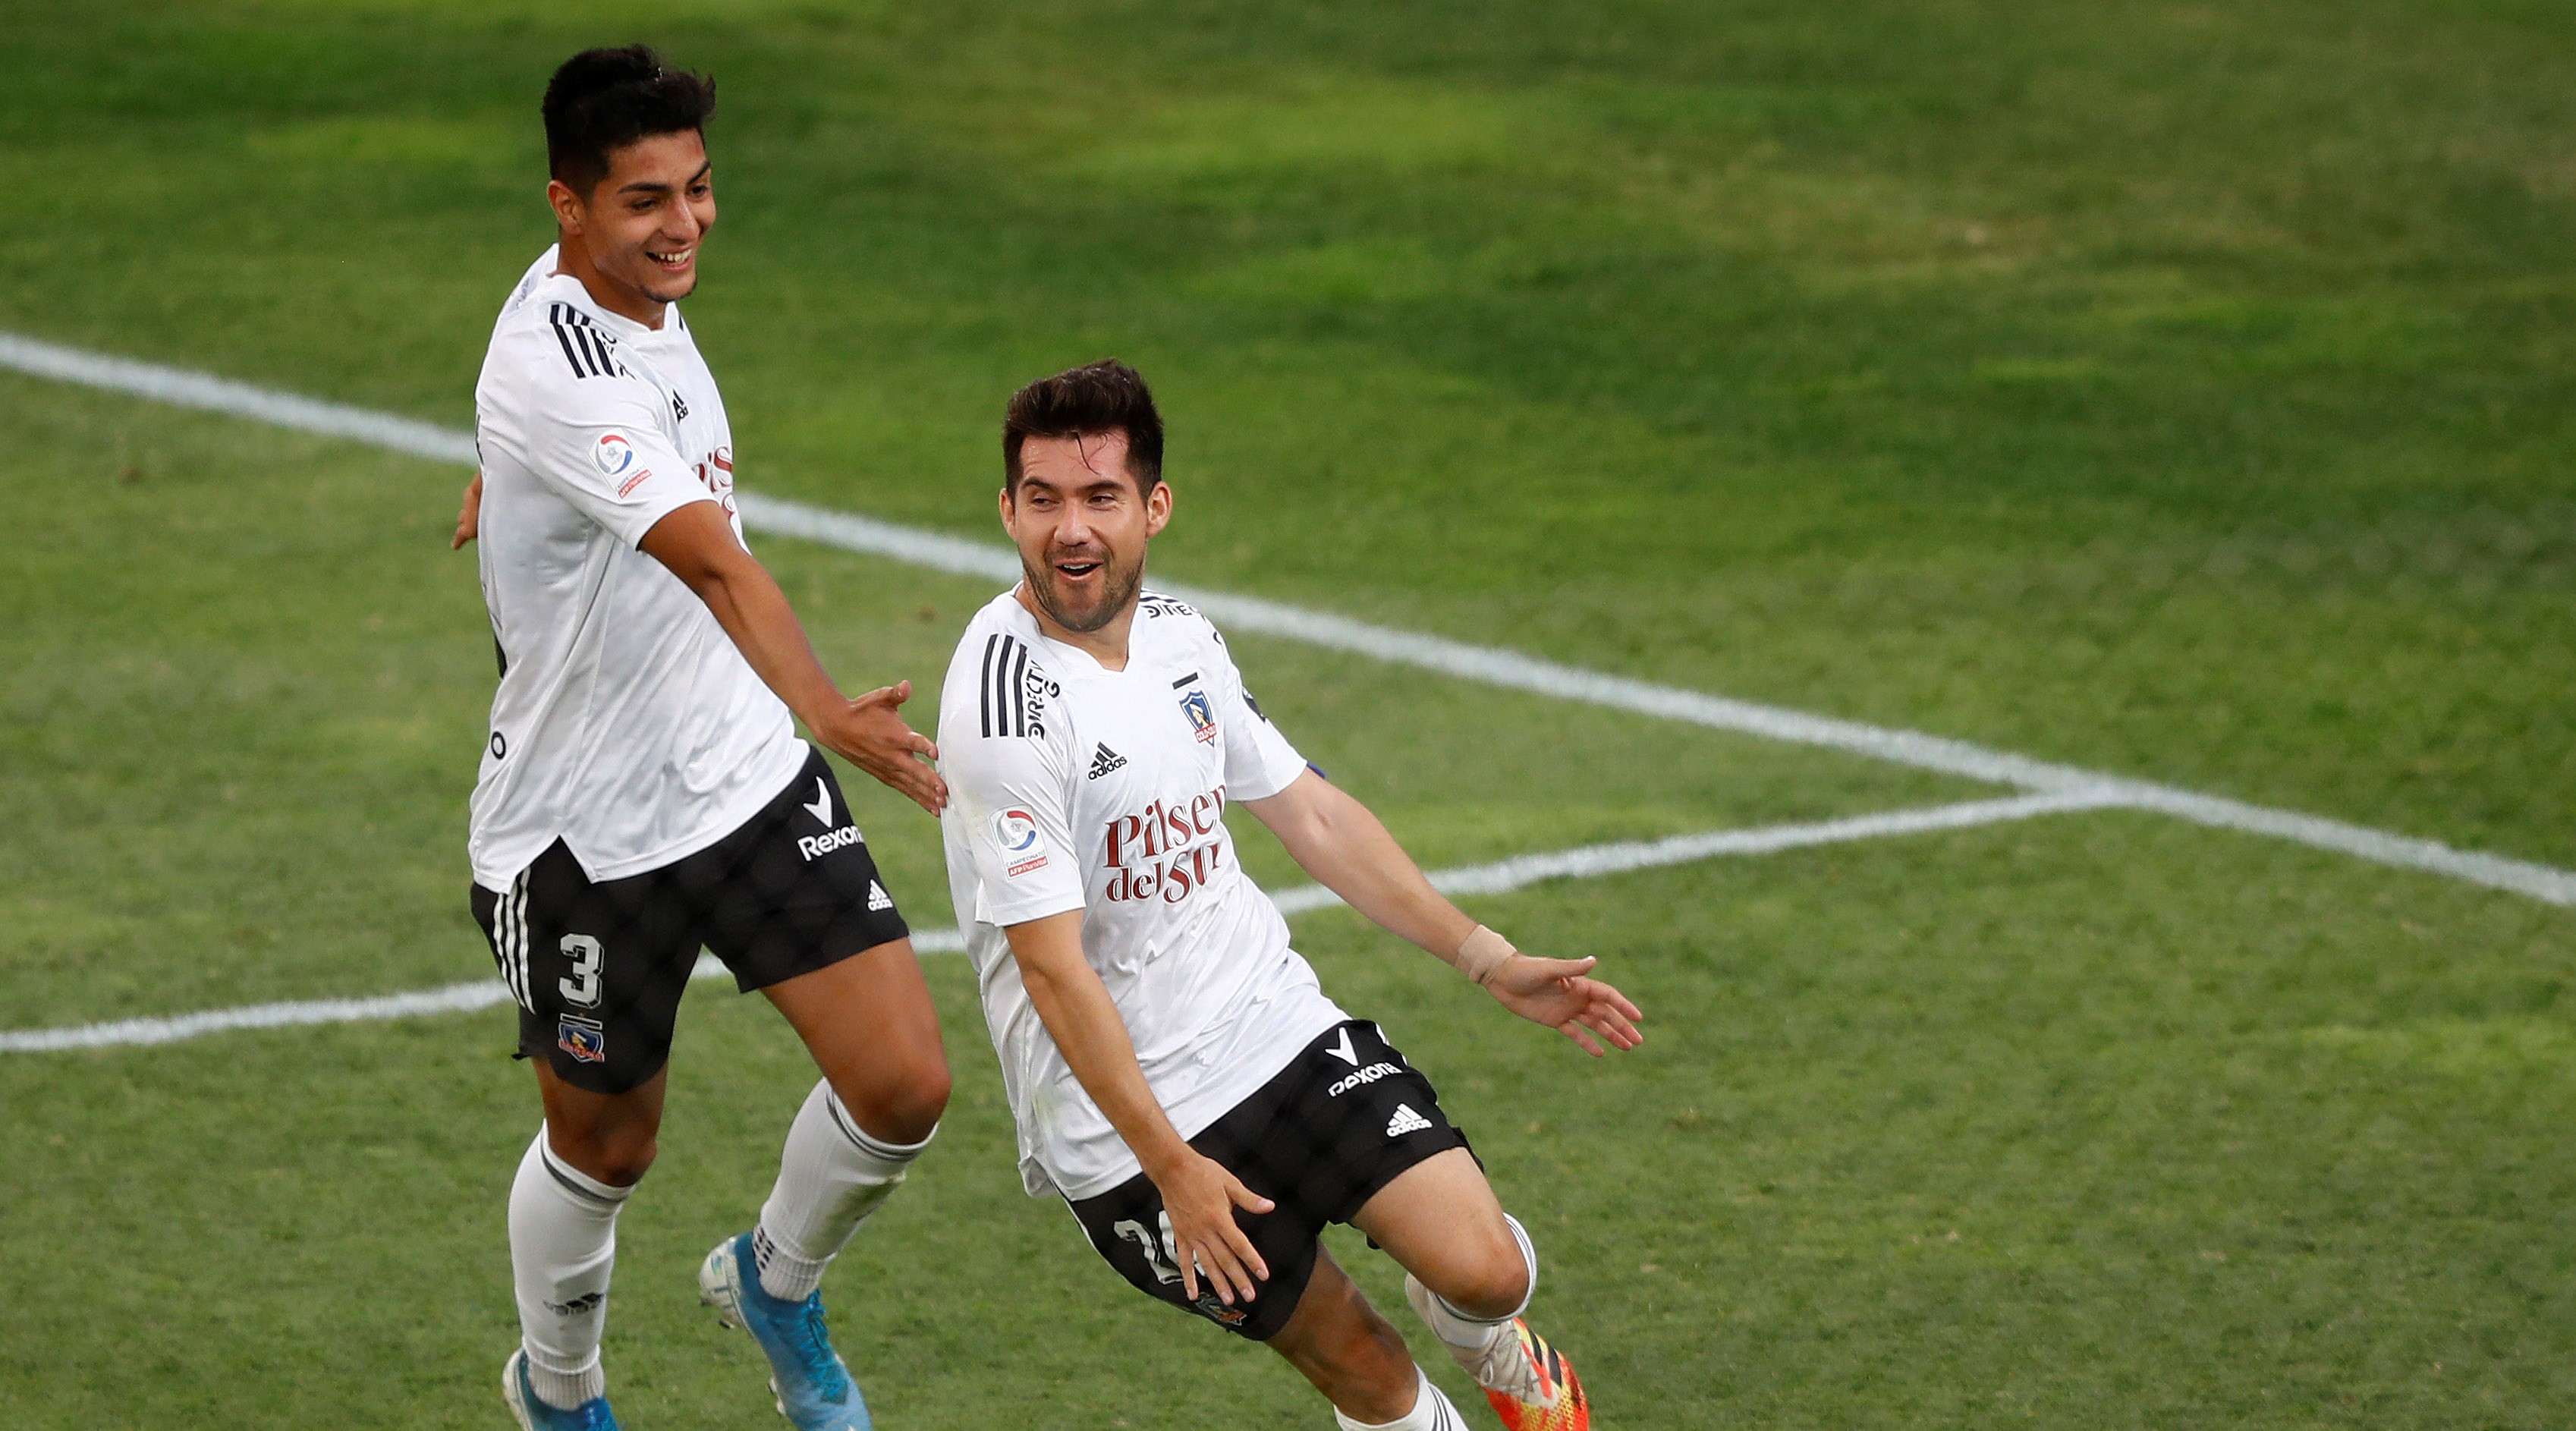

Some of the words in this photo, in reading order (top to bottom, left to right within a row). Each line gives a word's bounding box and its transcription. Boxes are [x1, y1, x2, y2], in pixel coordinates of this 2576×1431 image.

[1088, 756, 1128, 780] adidas
[797, 826, 864, 861] Rexon
[1106, 860, 1165, 902] del
[558, 933, 605, 1009] 3
[1386, 1118, 1433, 1137] adidas
